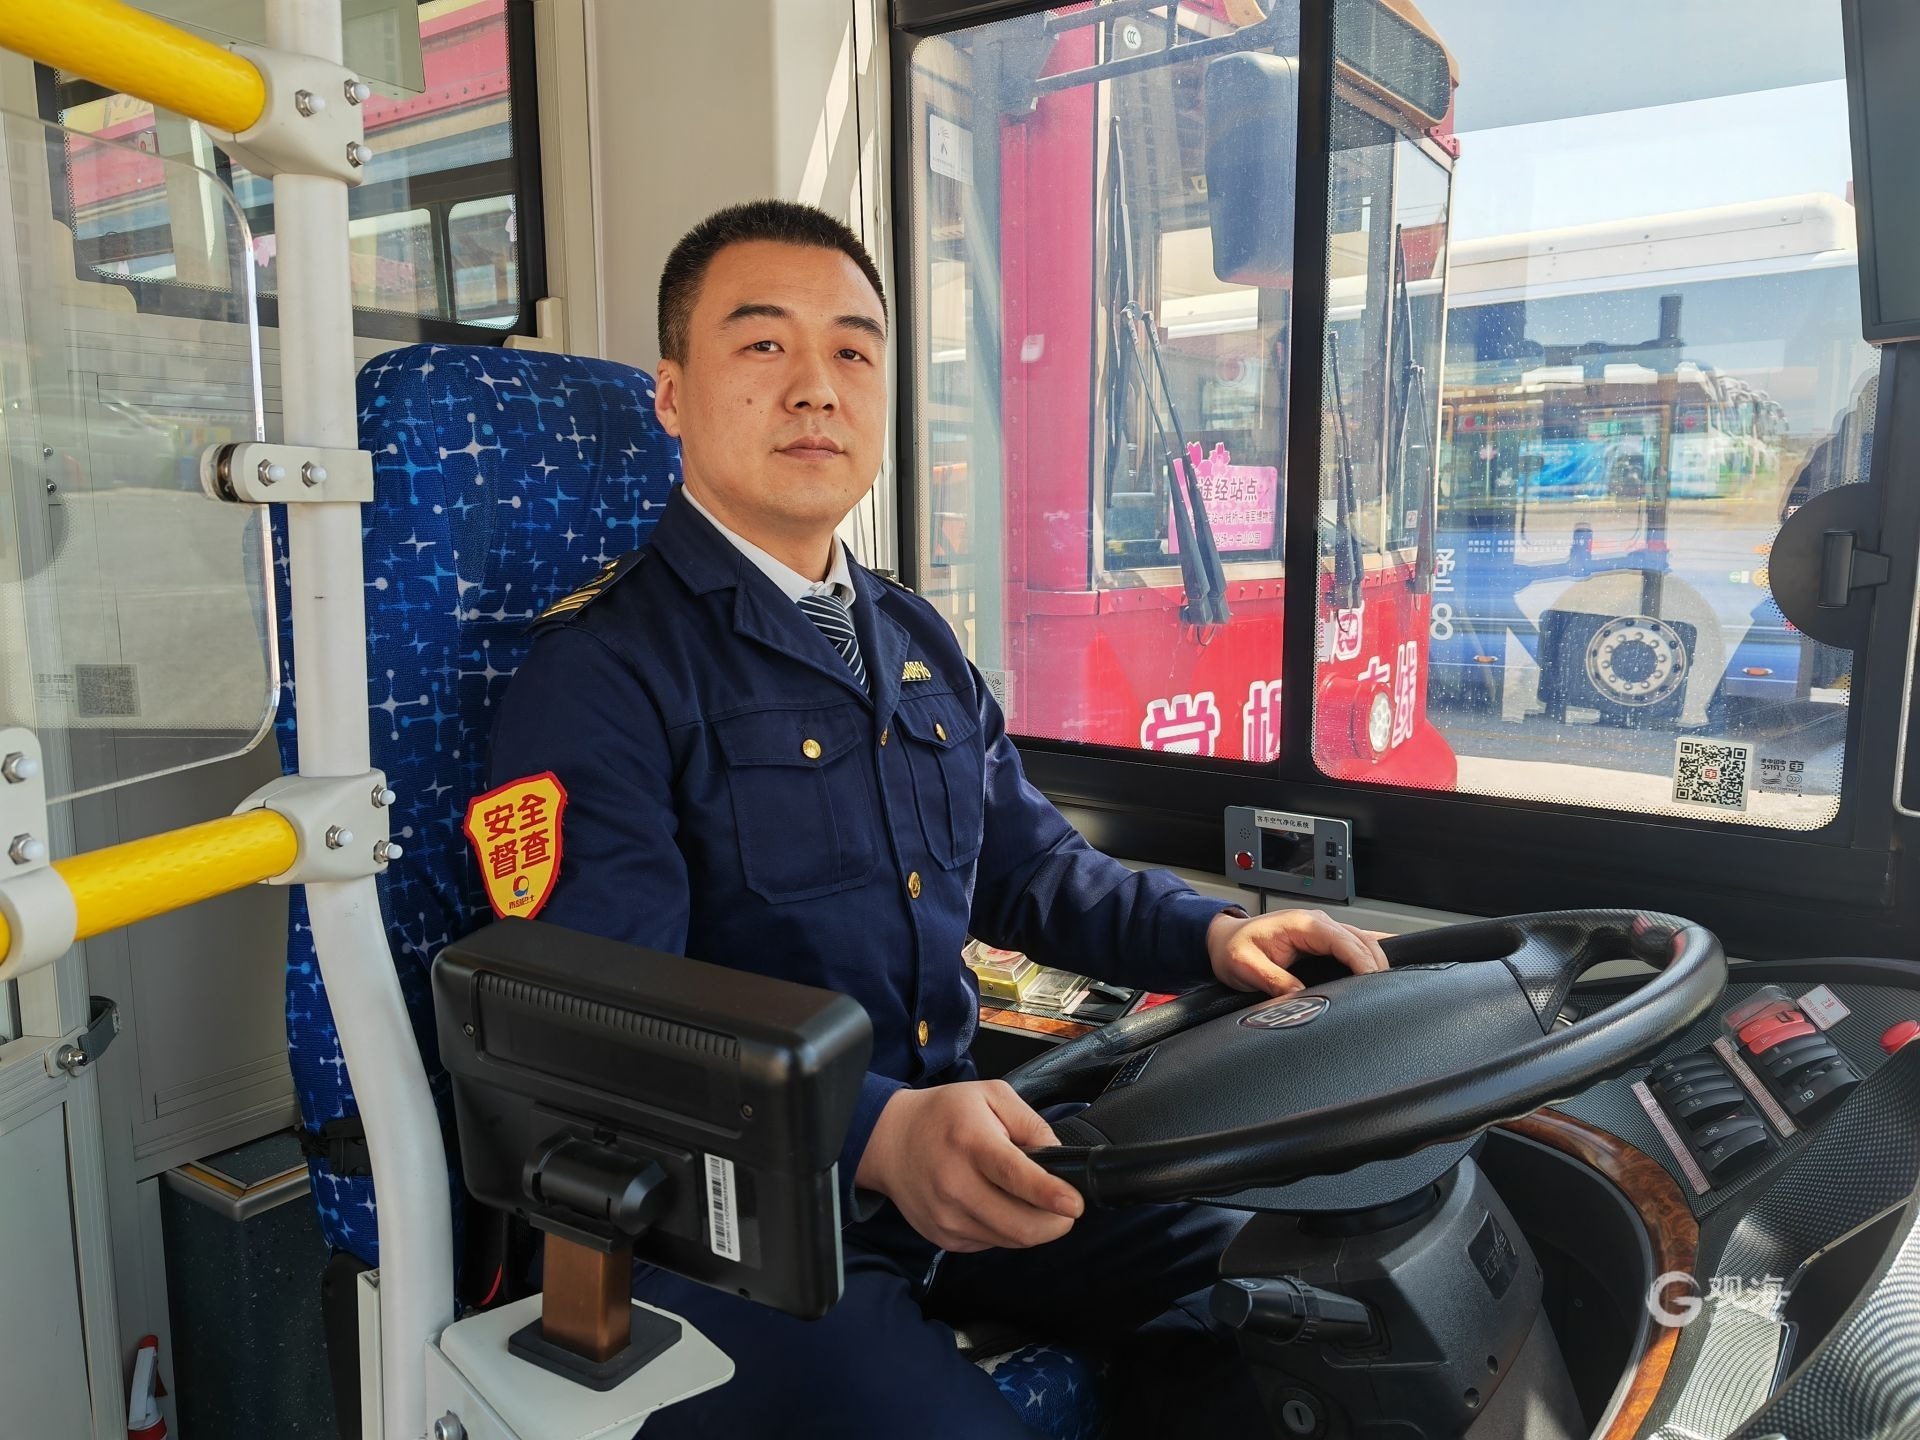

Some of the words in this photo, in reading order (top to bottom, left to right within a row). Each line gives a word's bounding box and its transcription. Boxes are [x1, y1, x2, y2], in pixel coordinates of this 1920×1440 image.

[484, 793, 548, 842] 安全
[1256, 815, 1310, 829] 客车空气净化系统
[488, 828, 551, 880] 督查
